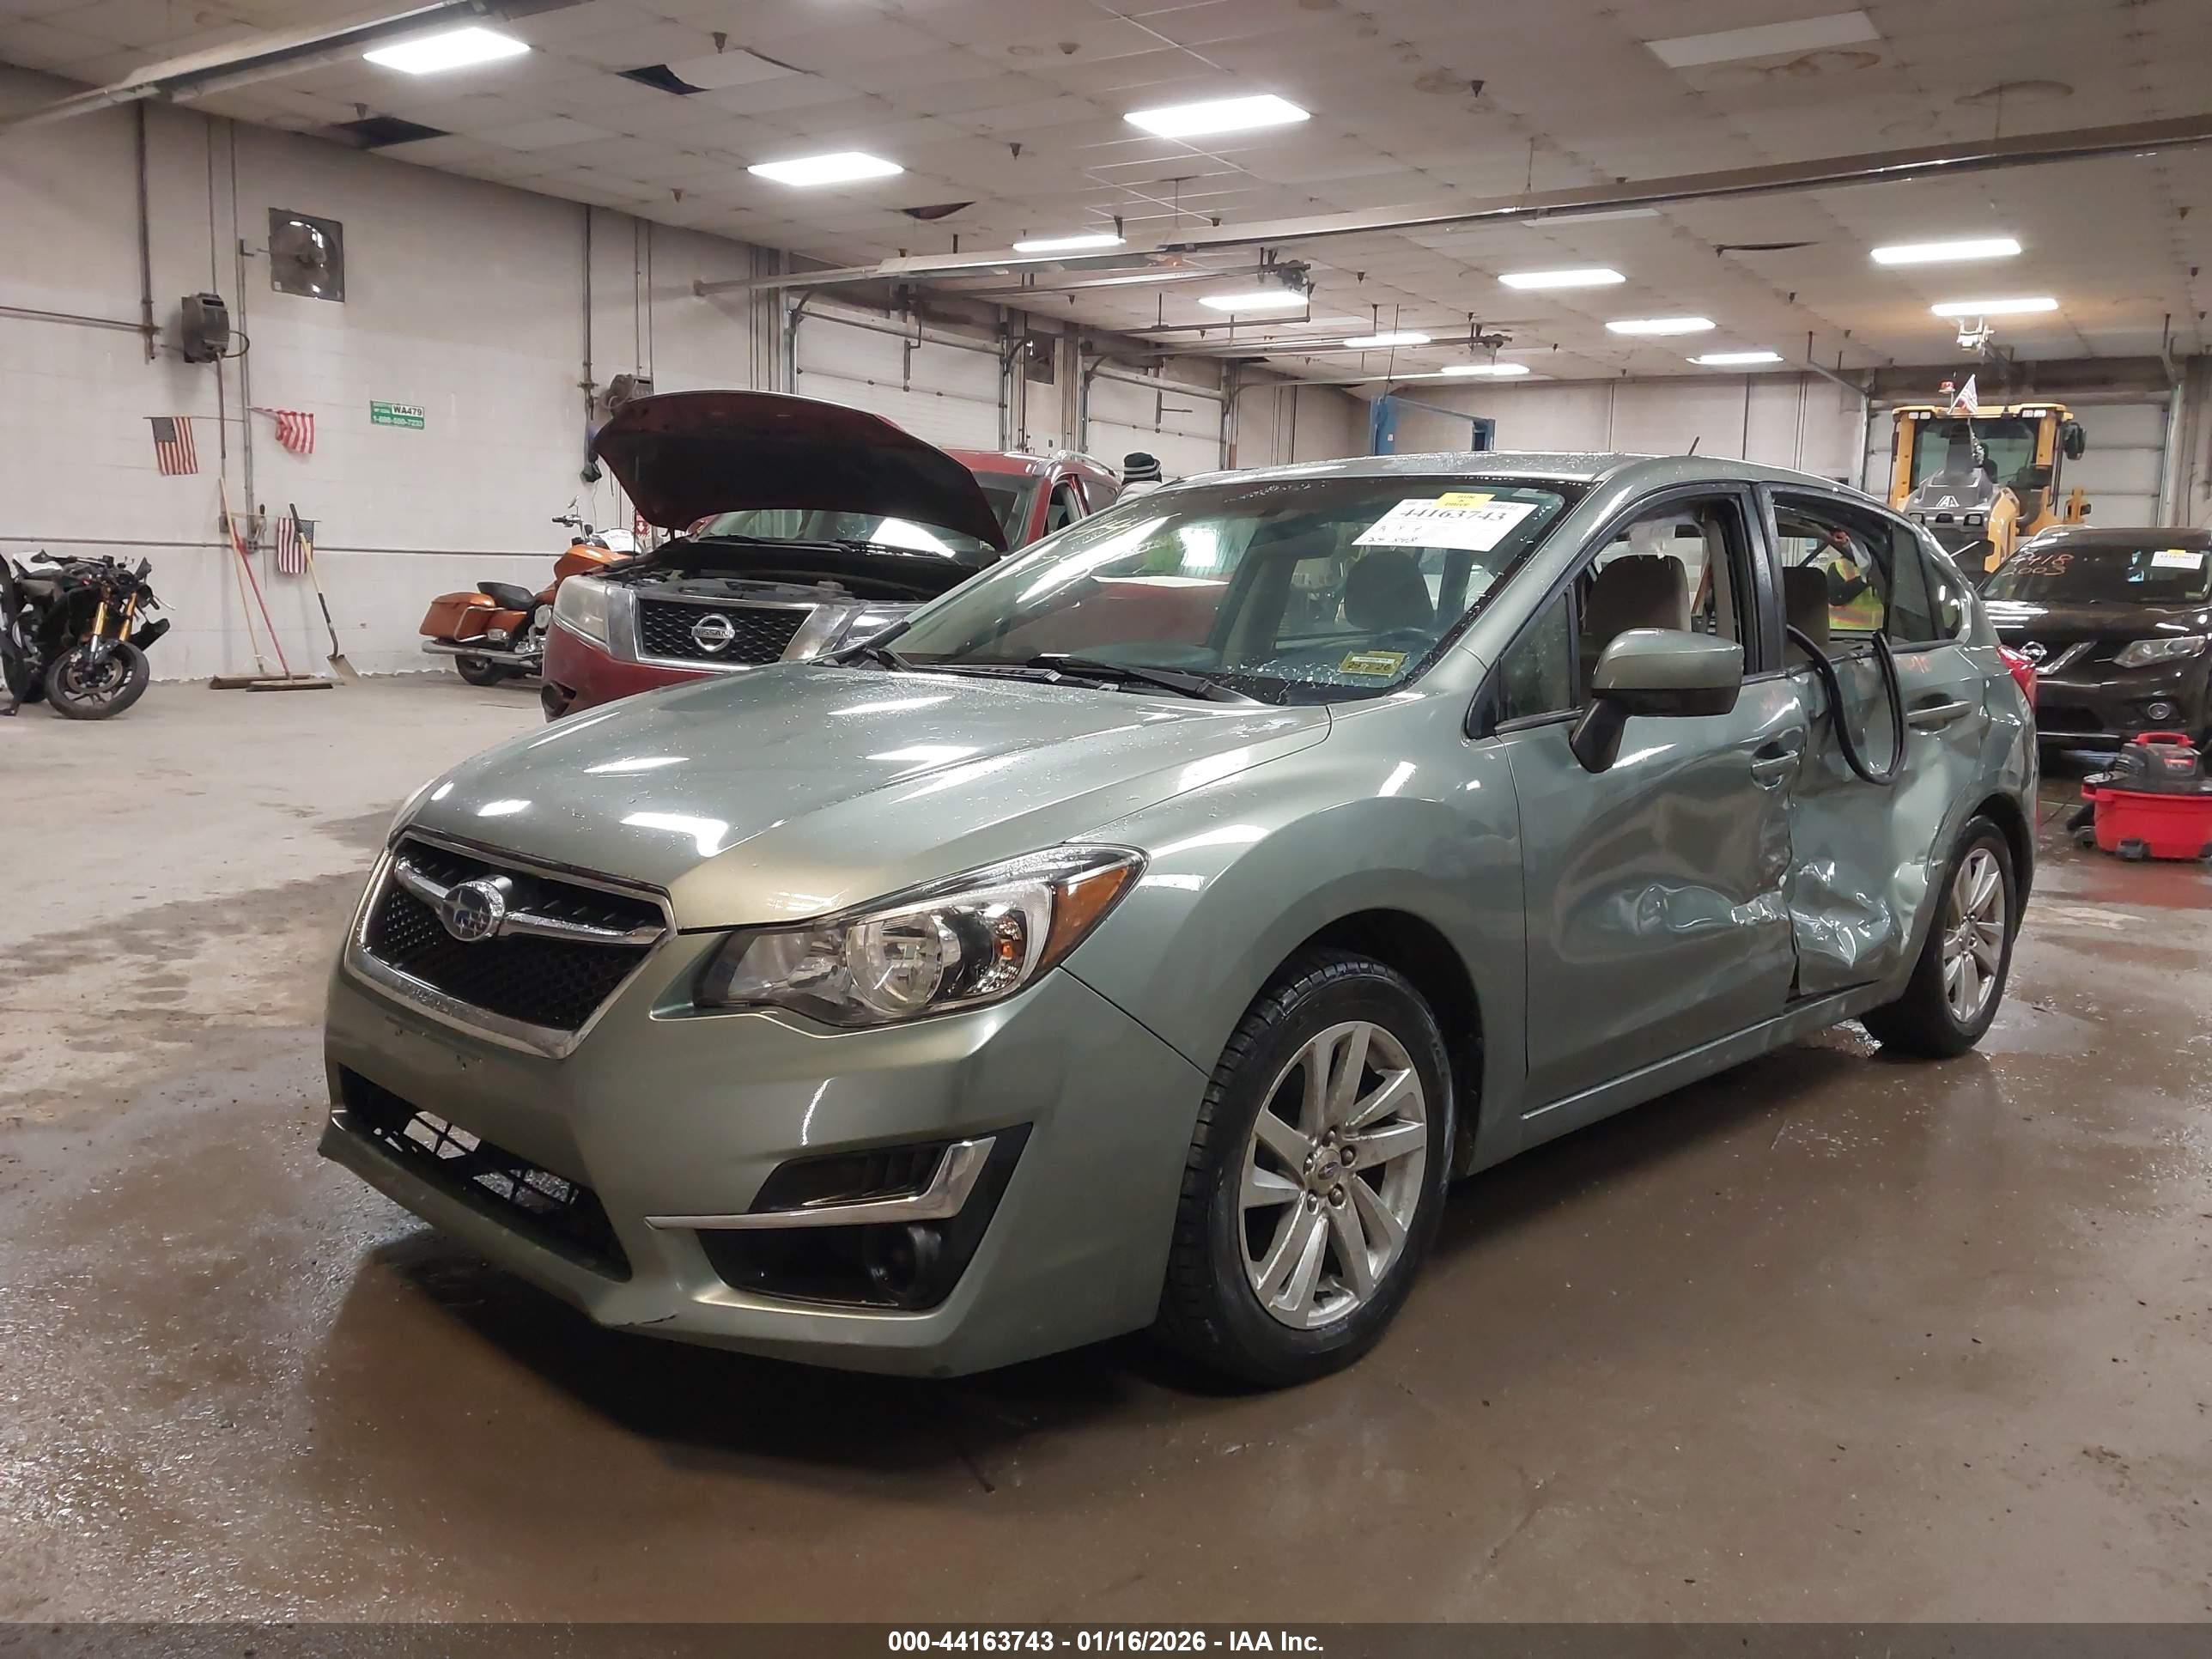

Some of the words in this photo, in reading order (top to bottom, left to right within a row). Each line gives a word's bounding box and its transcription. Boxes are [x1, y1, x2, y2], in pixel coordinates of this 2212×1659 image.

[393, 404, 422, 416] WA479
[1401, 507, 1507, 522] 44163743
[696, 628, 729, 637] NISSAN
